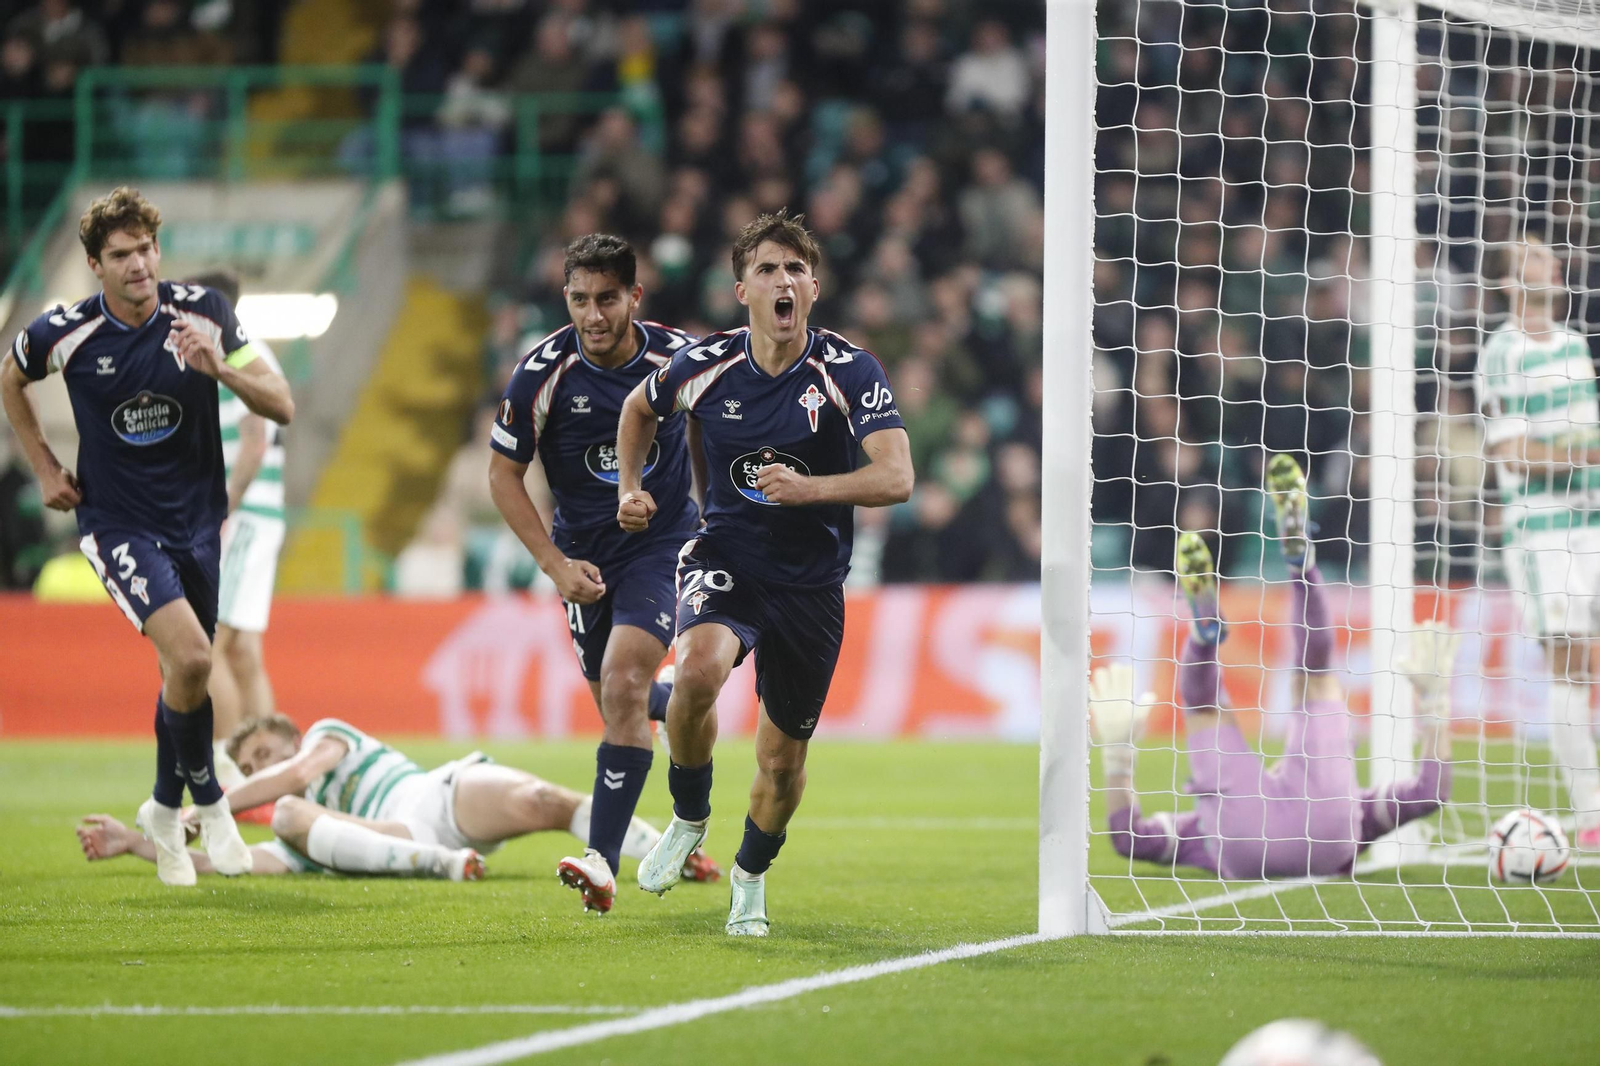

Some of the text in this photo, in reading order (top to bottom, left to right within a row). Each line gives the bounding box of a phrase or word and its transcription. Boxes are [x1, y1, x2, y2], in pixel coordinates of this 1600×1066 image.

[123, 403, 170, 422] Estrella
[722, 412, 742, 420] hummel
[860, 413, 871, 425] JP
[126, 416, 169, 434] Galicia
[111, 542, 137, 581] 3
[680, 569, 735, 601] 20
